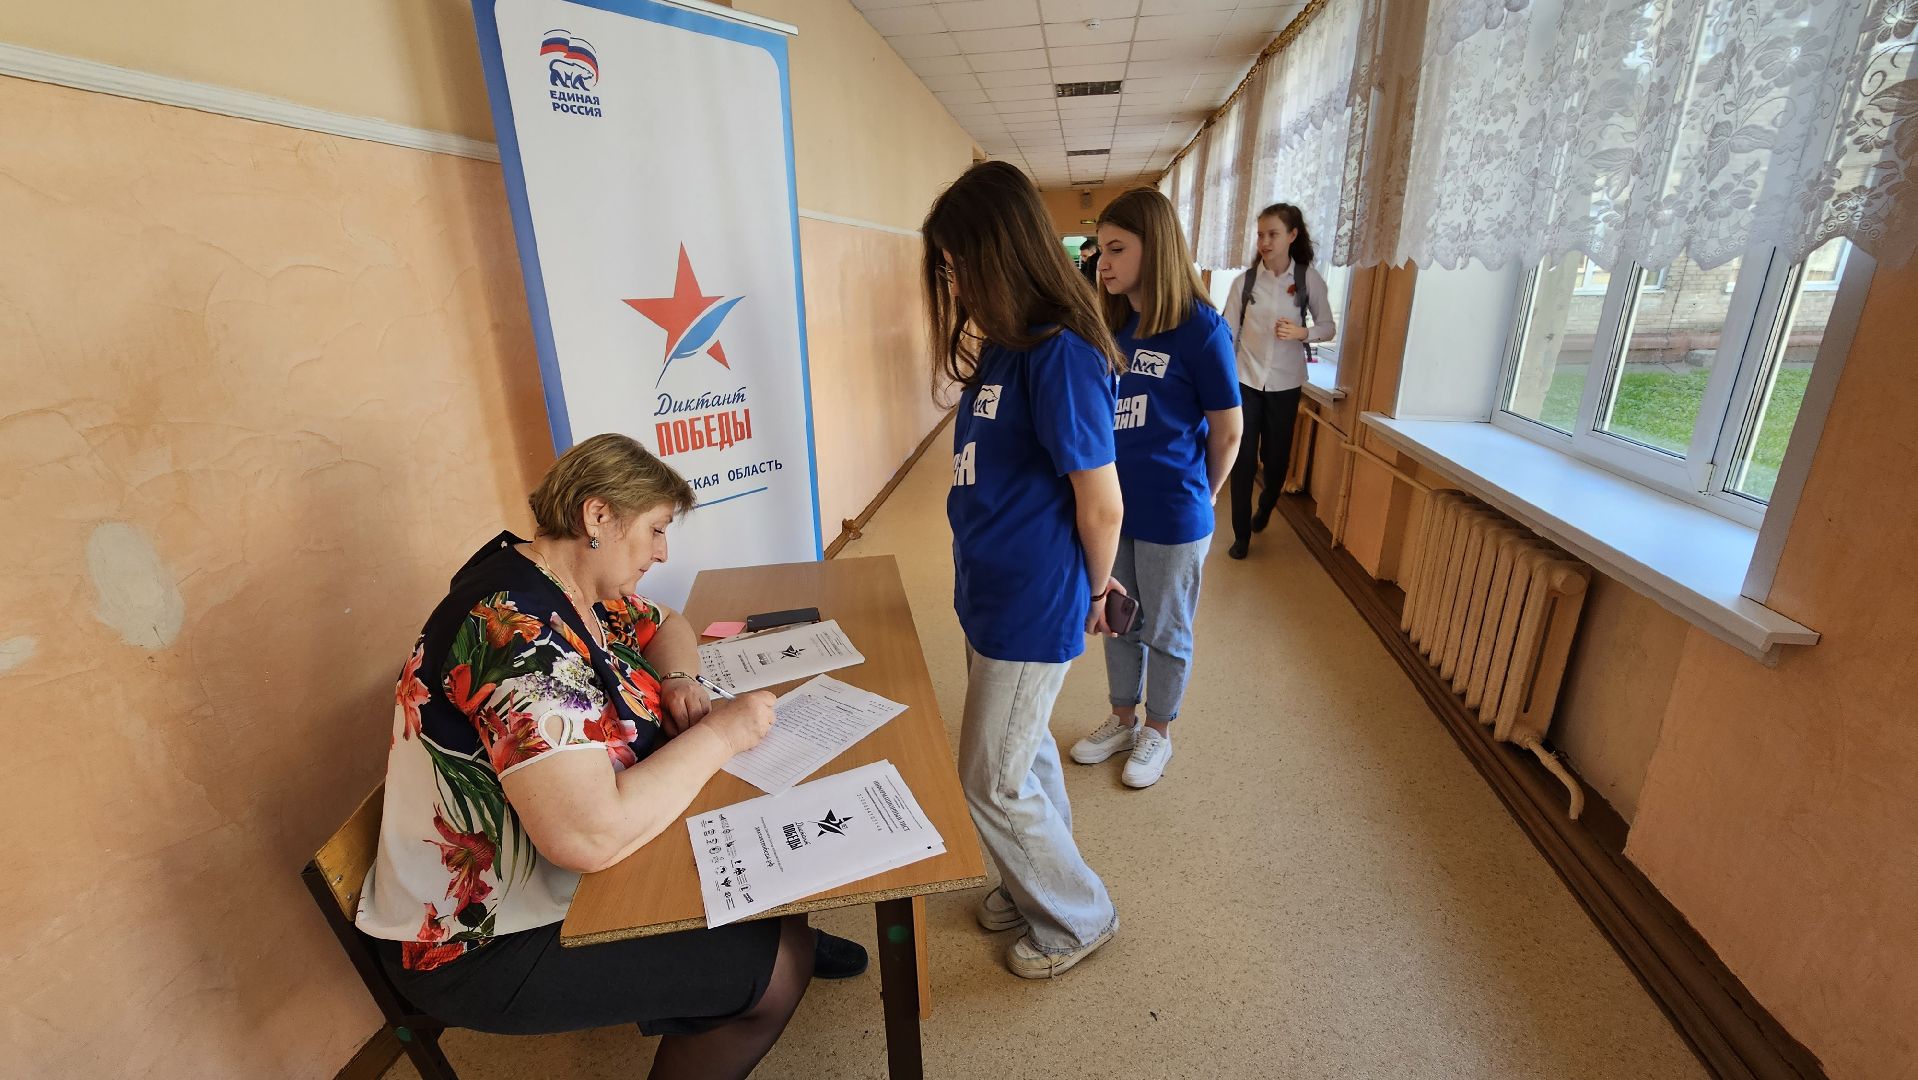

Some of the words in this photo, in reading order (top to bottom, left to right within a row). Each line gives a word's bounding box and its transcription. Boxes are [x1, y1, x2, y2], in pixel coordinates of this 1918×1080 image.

[549, 90, 600, 106] ЕДИНАЯ
[552, 102, 602, 117] РОССИЯ
[654, 387, 747, 416] Диктант
[655, 408, 752, 457] ПОБЕДЫ
[728, 460, 783, 481] ОБЛАСТЬ
[782, 823, 803, 851] ПОБЕДЫ
